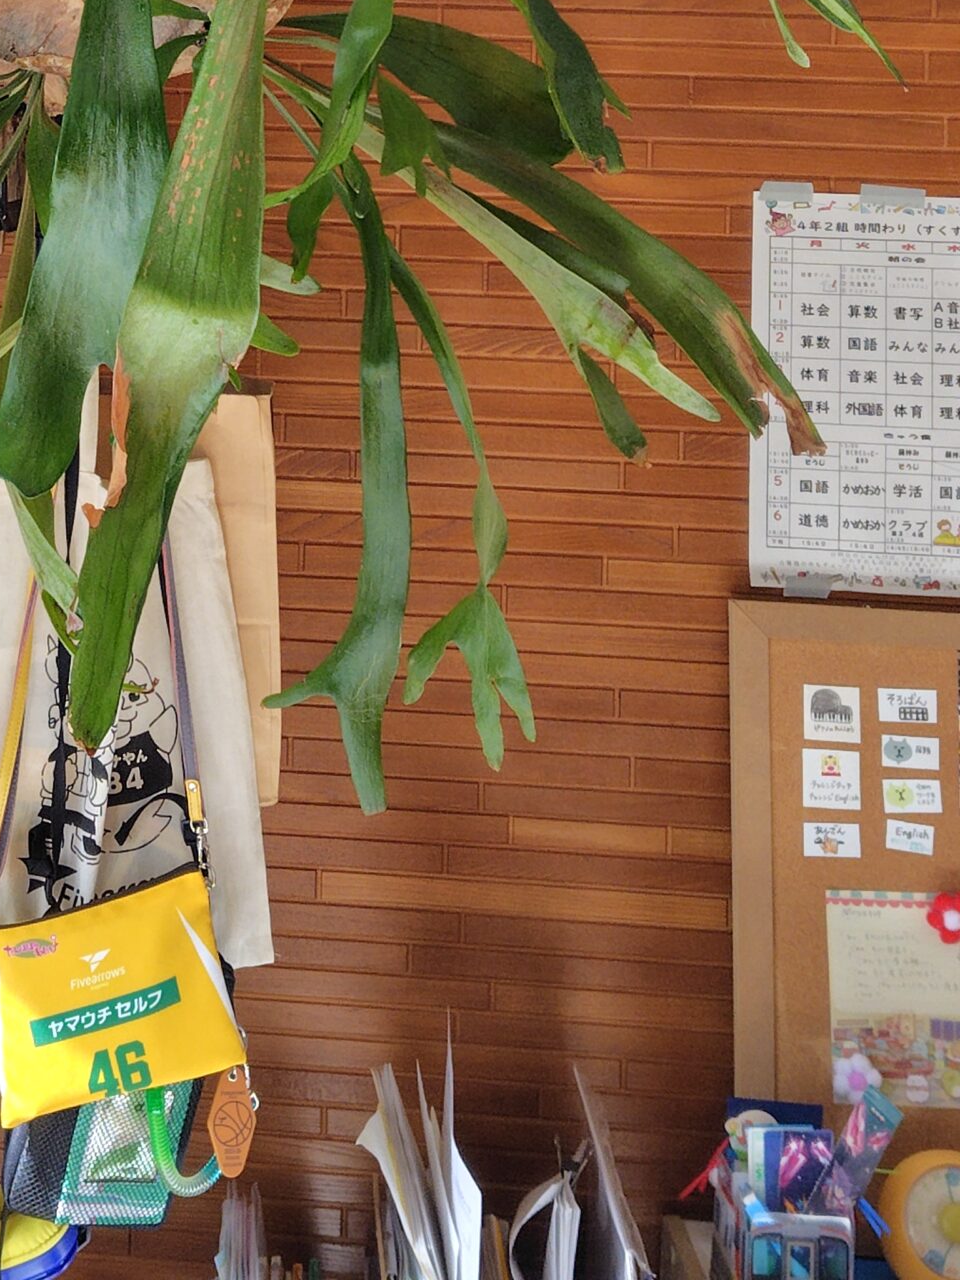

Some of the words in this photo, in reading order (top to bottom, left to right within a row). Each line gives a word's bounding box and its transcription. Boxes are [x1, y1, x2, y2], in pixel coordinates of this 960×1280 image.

[797, 221, 849, 233] 4年2組
[854, 222, 906, 234] 時間わり
[888, 256, 926, 264] 朝の会
[800, 303, 830, 317] 社会
[847, 304, 878, 319] 算数
[893, 307, 924, 320] 書写
[934, 302, 943, 312] A
[934, 318, 943, 329] B
[776, 331, 784, 343] 2
[800, 335, 830, 349] 算数
[848, 337, 877, 352] 国語
[888, 341, 928, 353] みんな
[800, 368, 830, 382] 体育
[847, 369, 878, 383] 音楽
[893, 371, 924, 386] 社会
[845, 402, 883, 416] 外国語
[893, 404, 923, 418] 体育
[774, 475, 782, 486] 5
[800, 479, 829, 494] 国語
[842, 483, 885, 497] かめおか
[893, 484, 923, 498] 学活
[773, 510, 782, 521] 6
[798, 513, 829, 528] 道徳
[842, 518, 885, 531] かめおか
[888, 519, 928, 531] クラブ
[886, 692, 927, 707] そろばん
[895, 826, 930, 840] English
[70, 966, 126, 990] Fivearrows
[88, 1040, 152, 1097] 46
